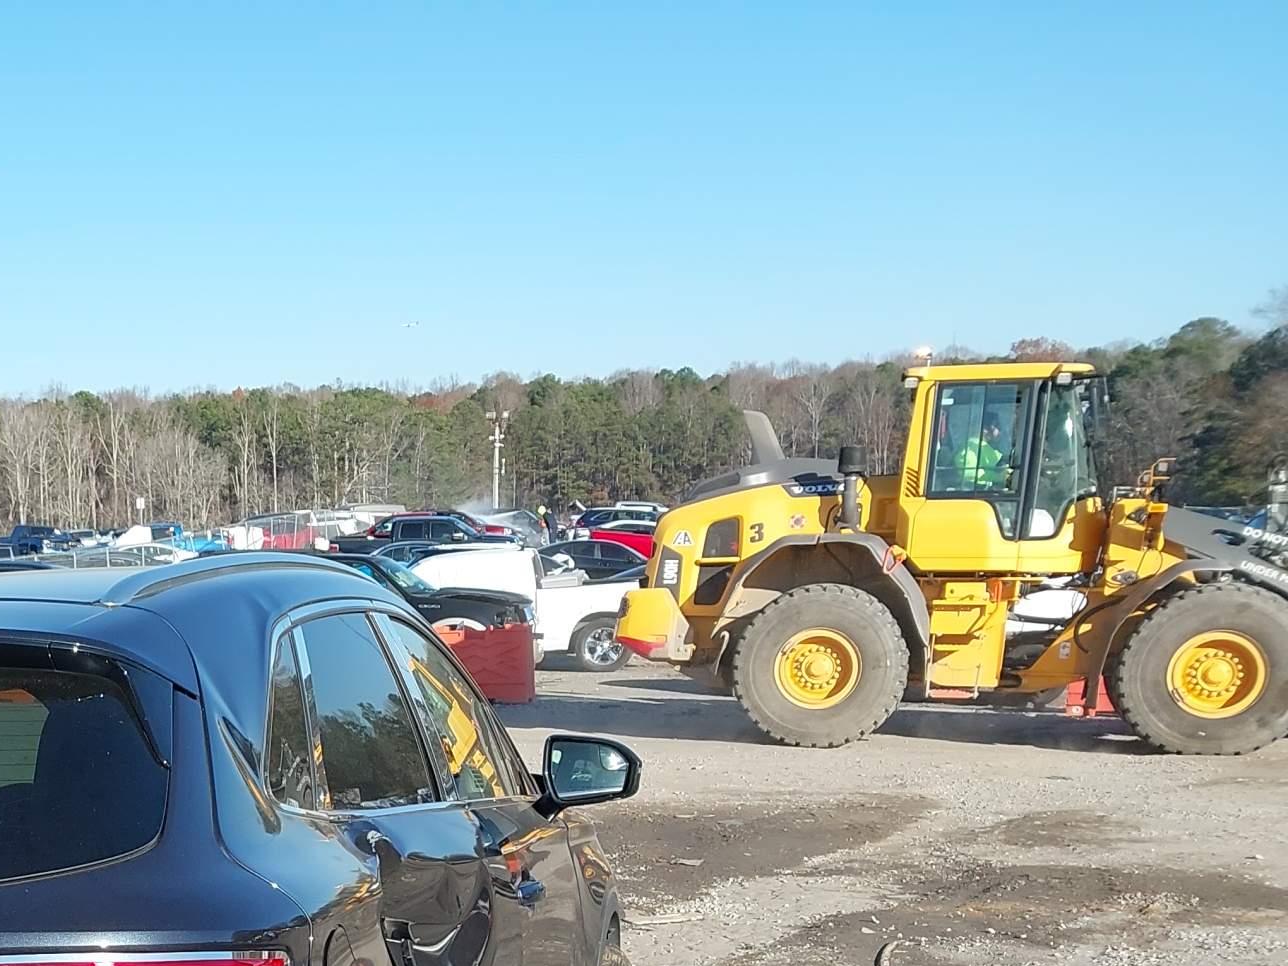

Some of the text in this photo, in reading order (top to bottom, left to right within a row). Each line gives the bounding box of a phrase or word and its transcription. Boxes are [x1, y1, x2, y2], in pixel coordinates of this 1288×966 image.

[749, 523, 764, 543] 3
[1243, 527, 1263, 538] DO
[663, 559, 680, 585] L90H
[1240, 561, 1279, 580] UNDER
